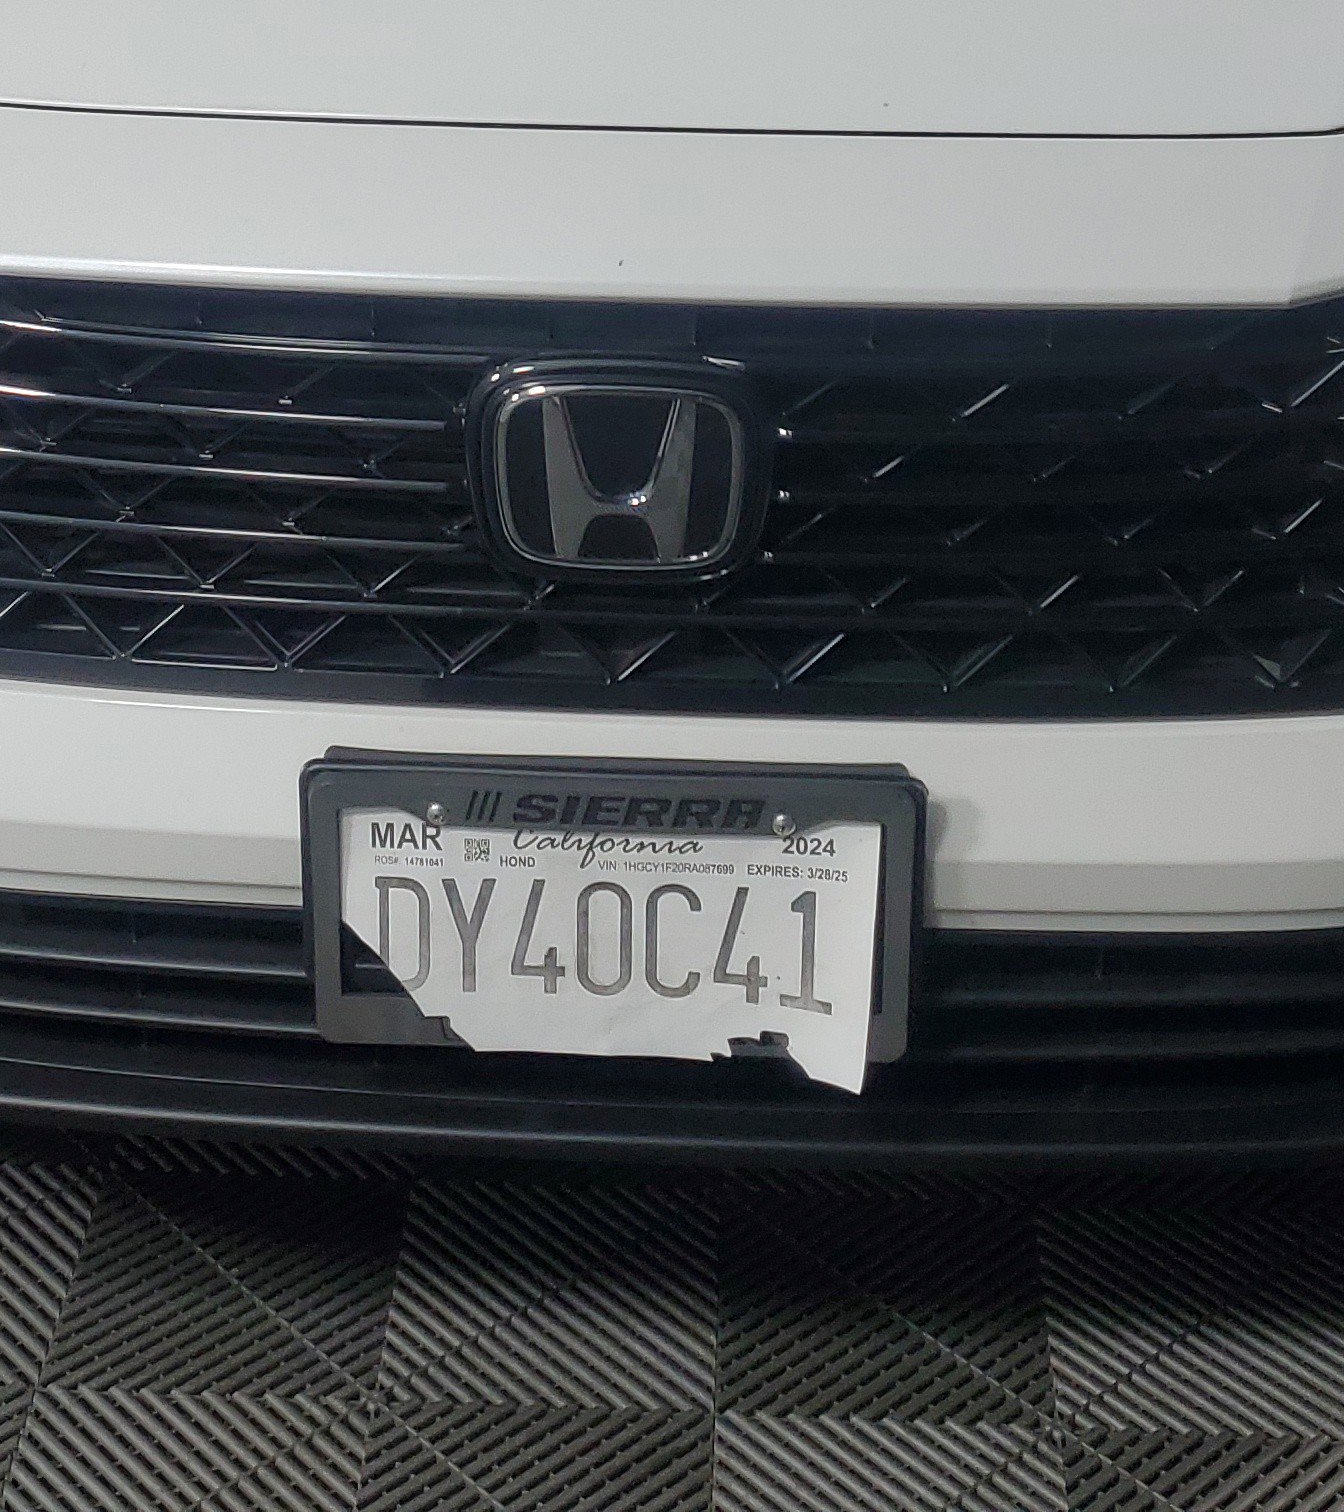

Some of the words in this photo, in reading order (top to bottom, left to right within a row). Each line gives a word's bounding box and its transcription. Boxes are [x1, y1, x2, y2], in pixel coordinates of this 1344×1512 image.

[513, 794, 766, 828] SIERRA
[370, 821, 443, 851] MAR
[513, 829, 703, 870] California
[781, 836, 836, 857] 2024
[499, 855, 536, 868] HOND
[747, 864, 804, 879] EXPIRES:
[807, 867, 848, 883] 3/28/25
[374, 876, 833, 1016] DY40C41
